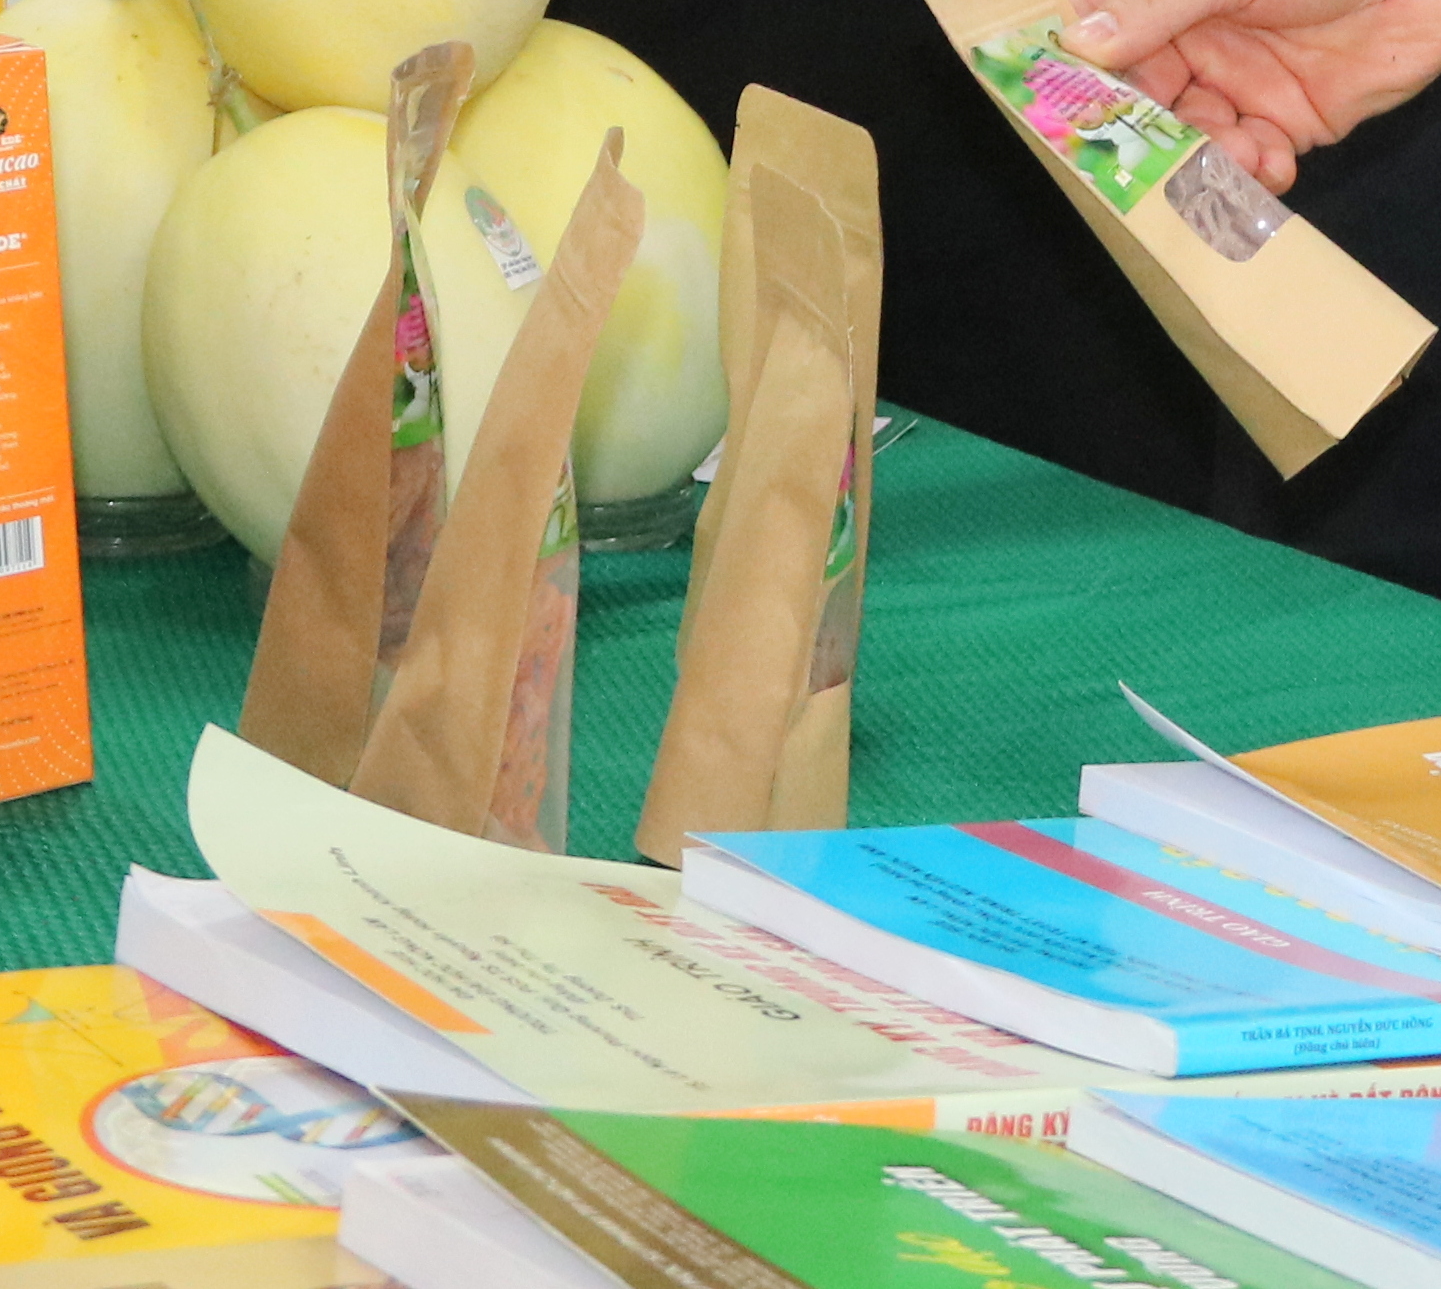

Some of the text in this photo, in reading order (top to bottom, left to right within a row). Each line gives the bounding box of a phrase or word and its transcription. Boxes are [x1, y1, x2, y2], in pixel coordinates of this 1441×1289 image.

[714, 981, 802, 1023] GIÁO
[1326, 1019, 1373, 1038] NGUYỄN
[1041, 1106, 1071, 1136] KÝ
[42, 1200, 152, 1242] VÀ
